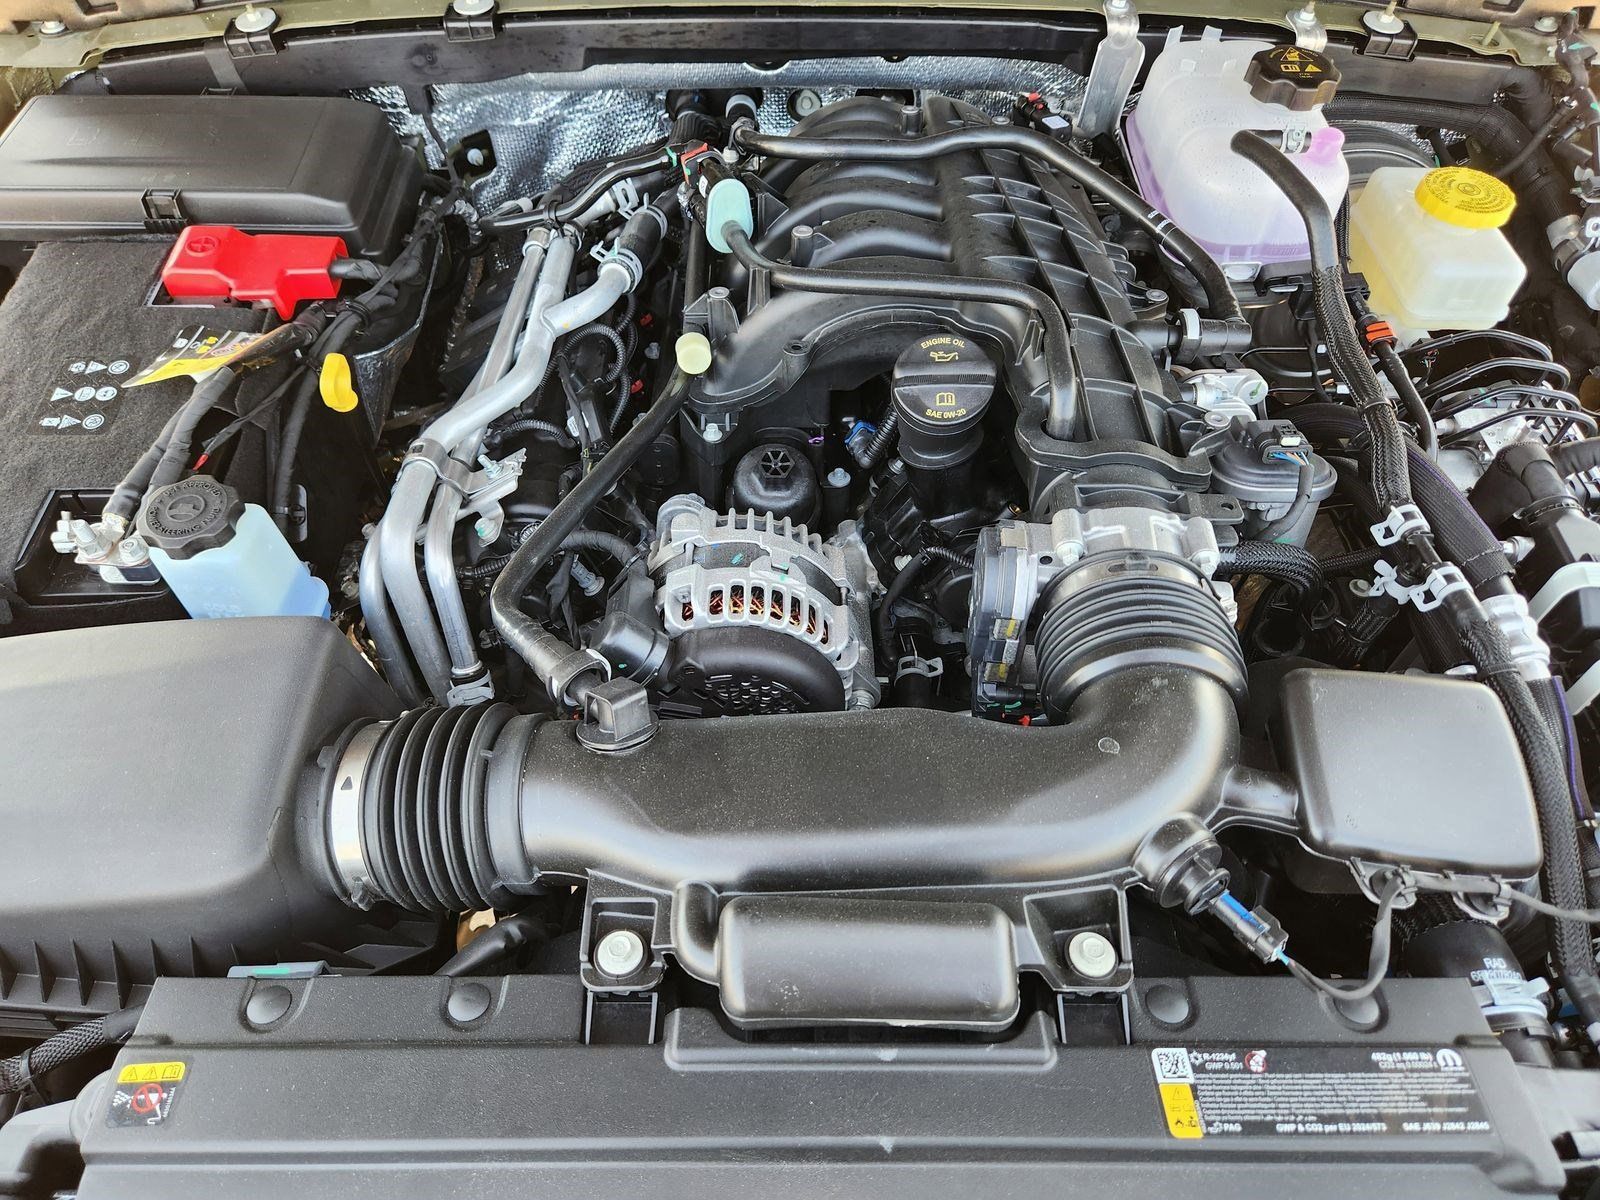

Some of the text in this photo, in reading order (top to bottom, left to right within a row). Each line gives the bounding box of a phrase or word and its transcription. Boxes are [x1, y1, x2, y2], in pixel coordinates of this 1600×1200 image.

[920, 337, 966, 349] ENGINE OIL
[925, 408, 967, 419] SAE 0W-20
[1483, 957, 1507, 969] RAD
[1223, 1123, 1242, 1132] PAG
